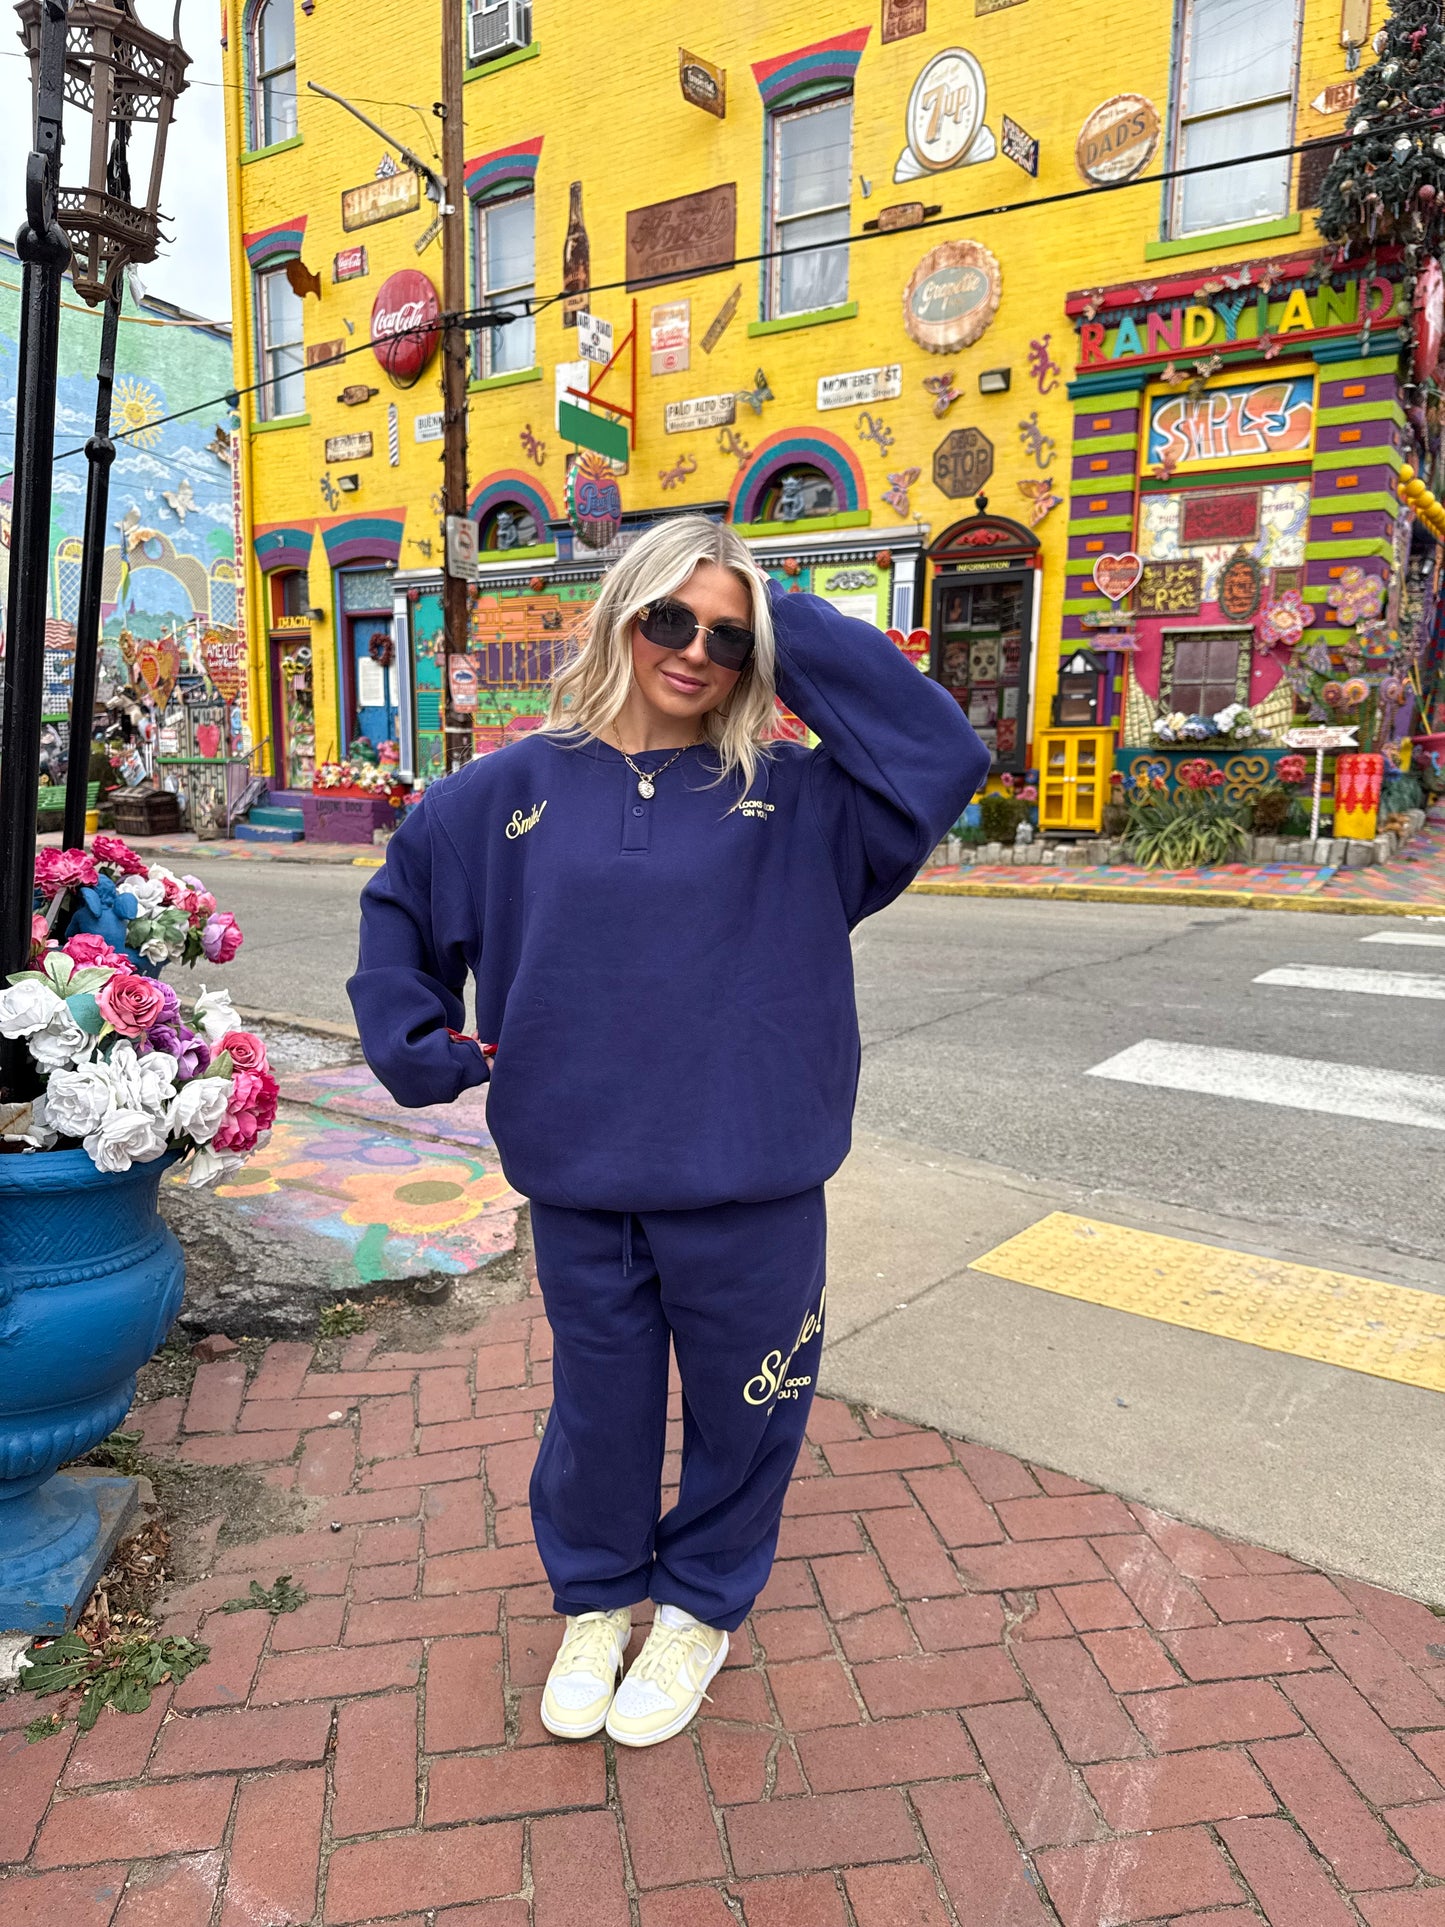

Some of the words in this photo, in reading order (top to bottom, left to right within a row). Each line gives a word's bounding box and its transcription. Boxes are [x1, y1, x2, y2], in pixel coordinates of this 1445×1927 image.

[1086, 112, 1145, 167] DAD'S
[938, 448, 988, 479] STOP
[505, 799, 548, 840] Smile!
[742, 809, 755, 817] ON
[784, 1376, 812, 1388] GOOD
